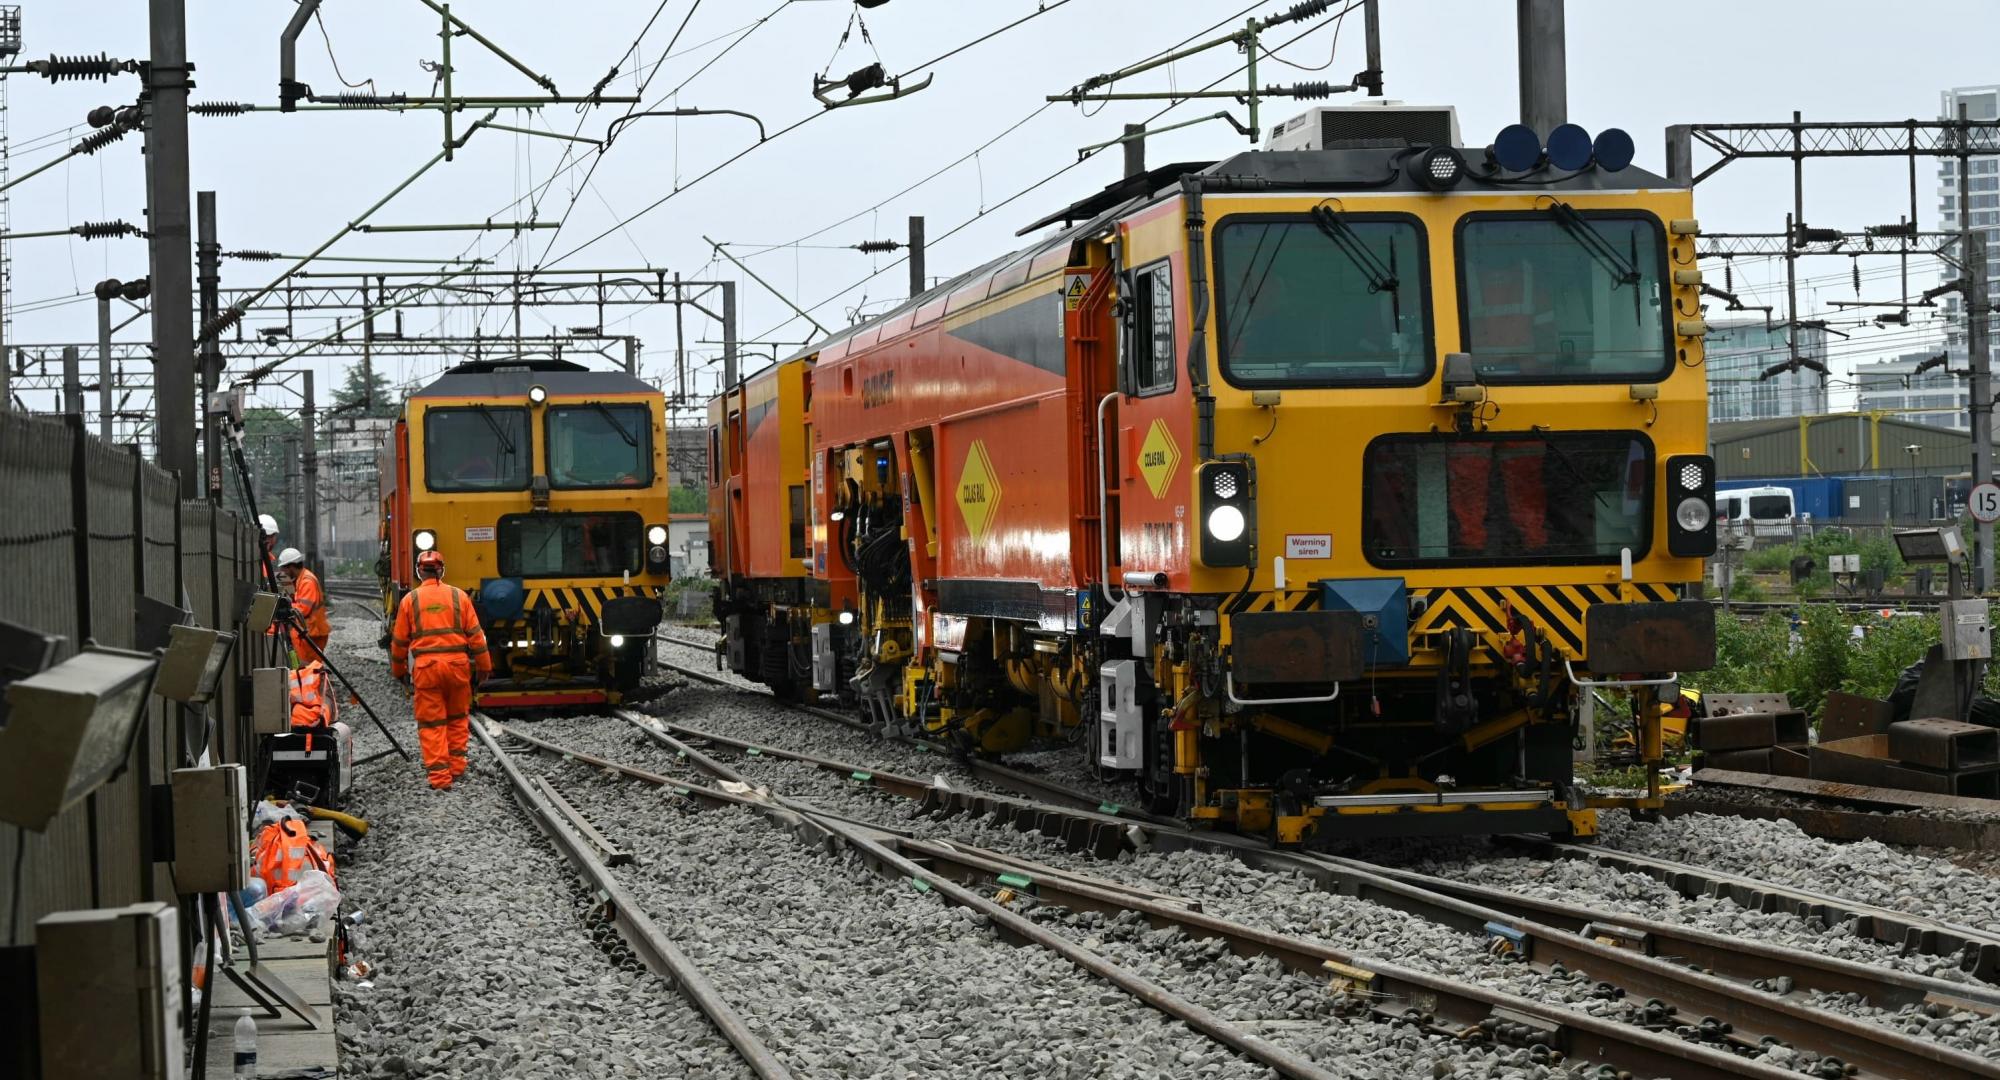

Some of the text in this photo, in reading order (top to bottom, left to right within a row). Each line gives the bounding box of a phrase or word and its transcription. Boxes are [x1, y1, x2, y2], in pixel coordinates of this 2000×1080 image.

[1145, 451, 1165, 467] COLAS RAIL
[963, 483, 985, 504] COLAS RAIL
[1979, 492, 1996, 512] 15
[1292, 538, 1326, 547] Warning
